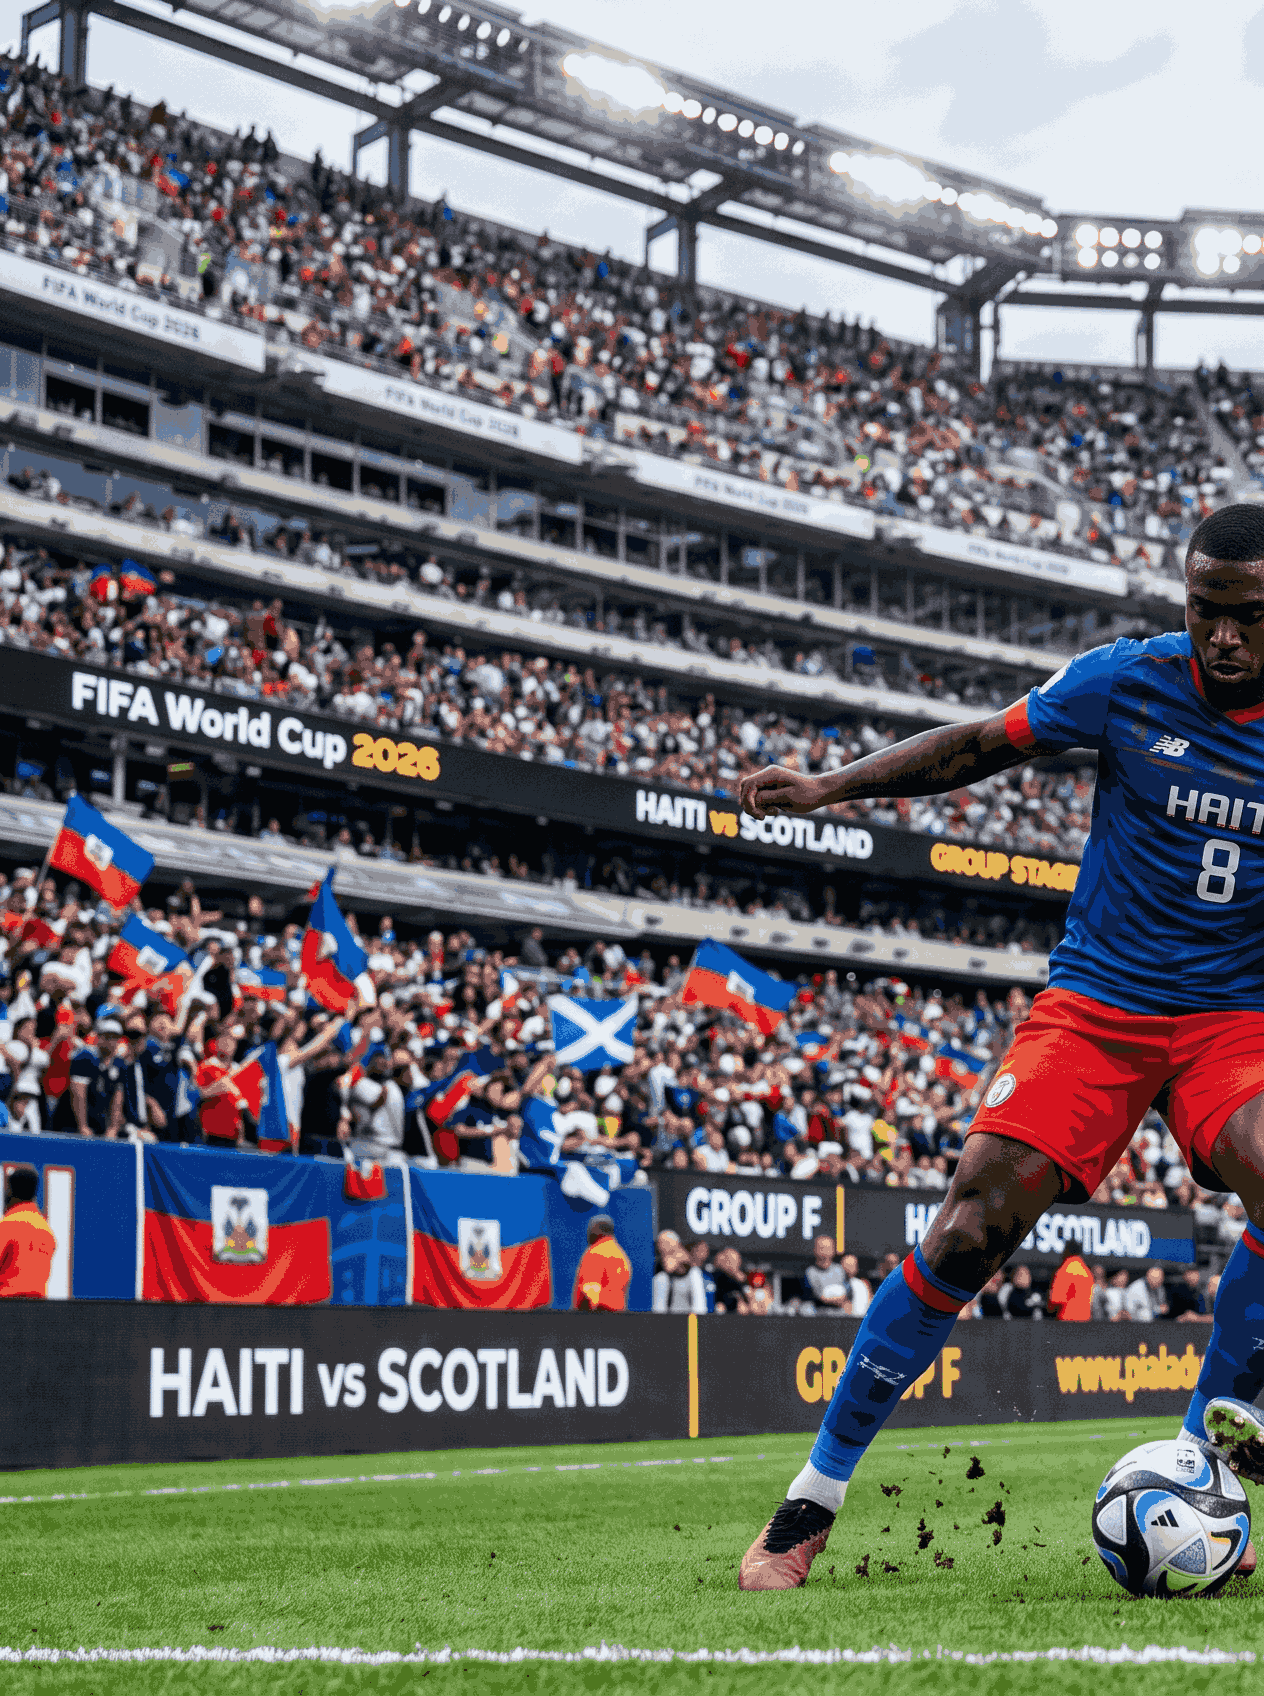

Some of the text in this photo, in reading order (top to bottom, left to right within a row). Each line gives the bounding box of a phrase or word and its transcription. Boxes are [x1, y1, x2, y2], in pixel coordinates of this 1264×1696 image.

[71, 671, 441, 781] FIFA World Cup 2026
[636, 789, 707, 832] HAITI
[740, 810, 874, 859] SCOTLAND
[930, 842, 1010, 880] GROUP
[1196, 838, 1241, 904] 8
[686, 1186, 823, 1240] GROUP F
[1036, 1212, 1151, 1258] SCOTLAND
[149, 1346, 630, 1417] HAITI vs SCOTLAND
[941, 1345, 963, 1399] F
